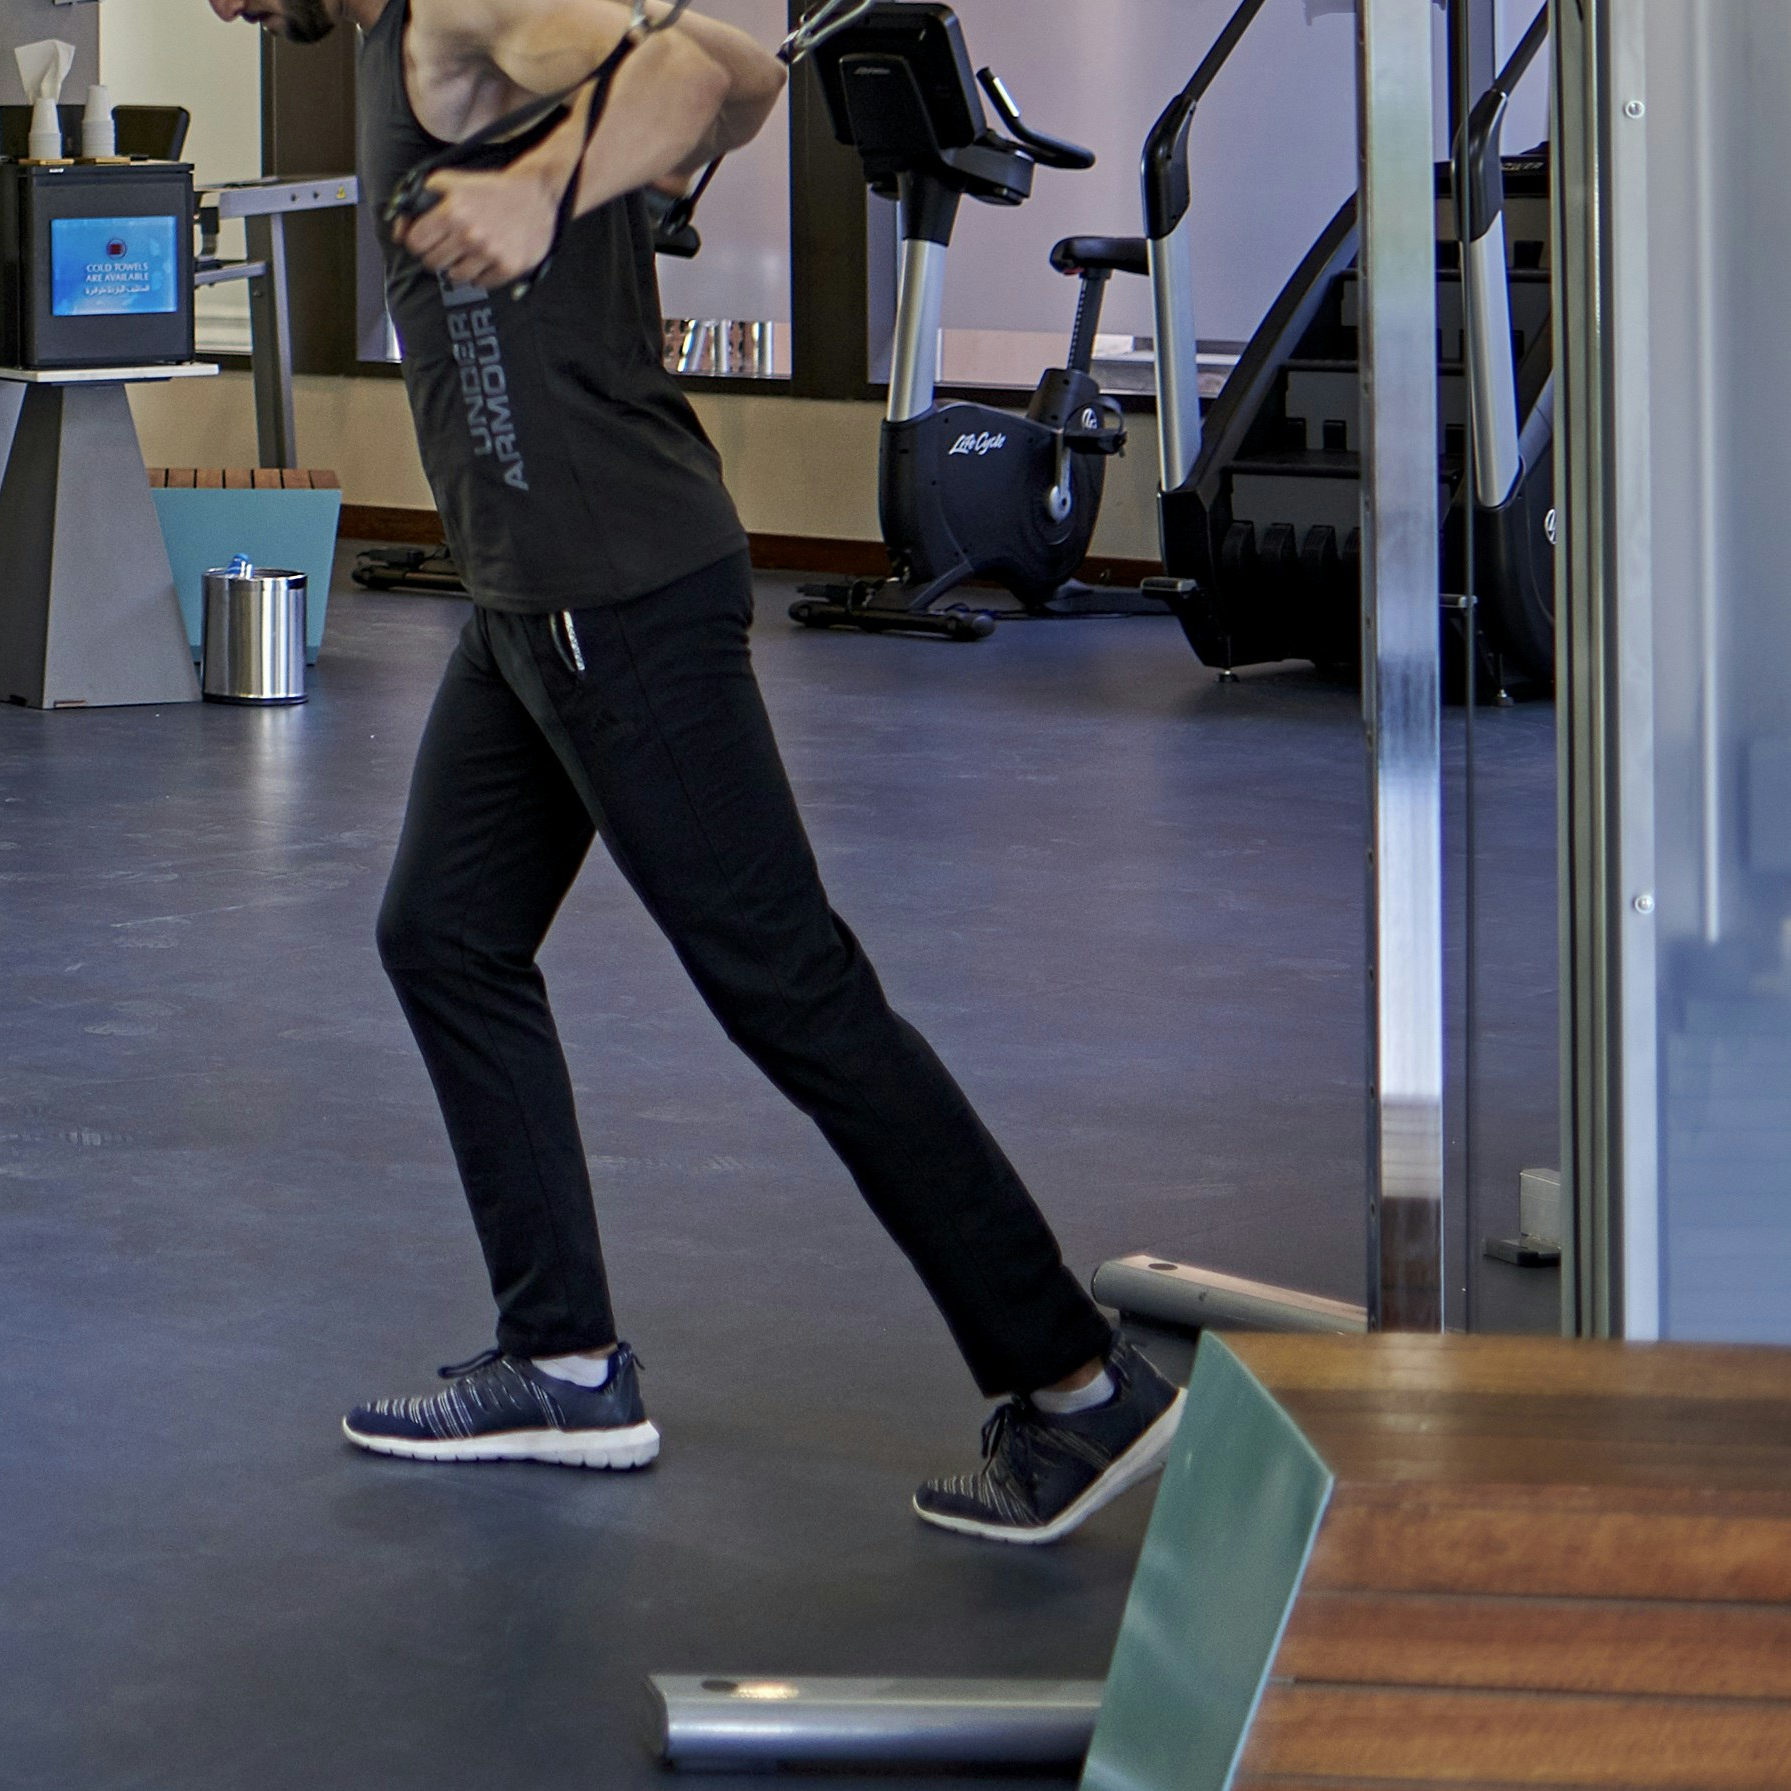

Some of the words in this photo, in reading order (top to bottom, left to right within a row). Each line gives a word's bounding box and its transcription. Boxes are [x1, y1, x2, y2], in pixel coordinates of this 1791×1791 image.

[86, 263, 112, 273] COLD
[114, 262, 149, 272] TOWELS
[86, 274, 102, 282] ARE
[104, 272, 149, 281] AVAILABLE
[447, 312, 493, 456] UNDER
[470, 307, 529, 492] ARMOUR
